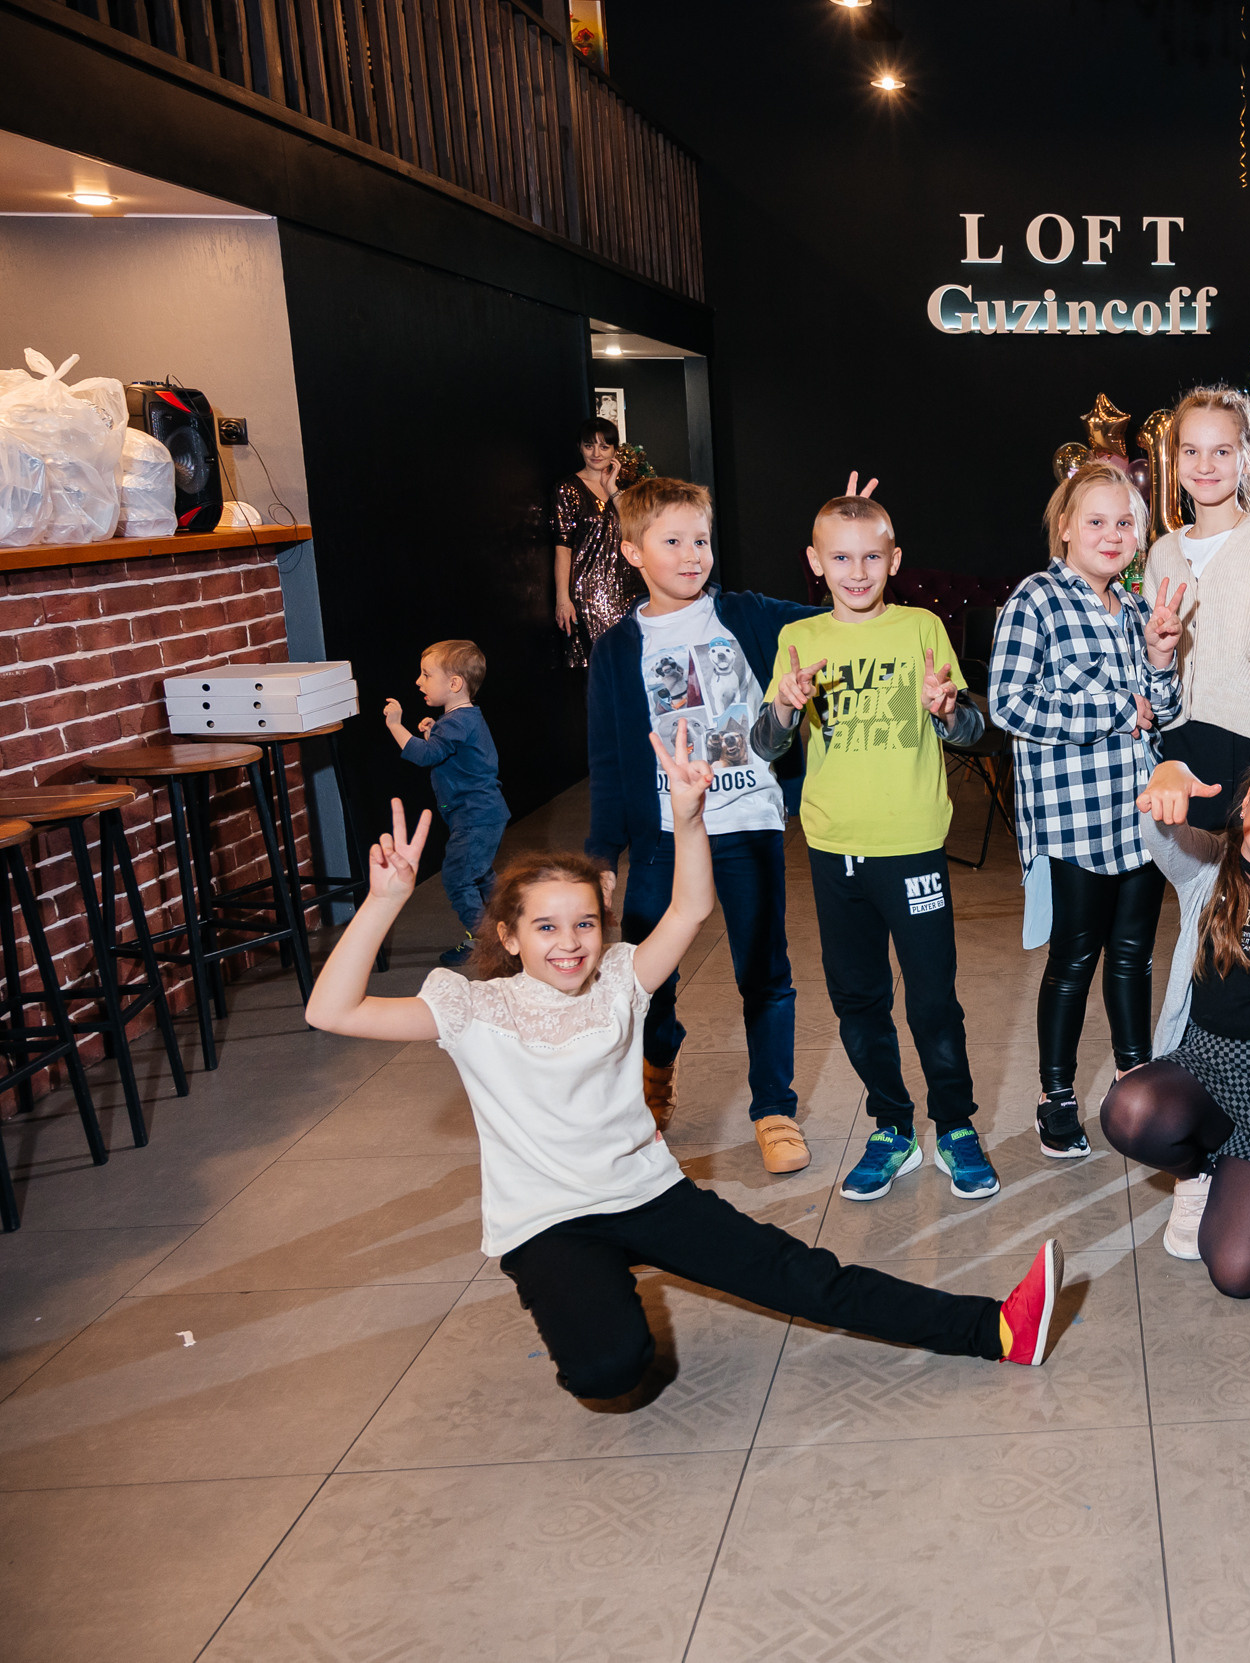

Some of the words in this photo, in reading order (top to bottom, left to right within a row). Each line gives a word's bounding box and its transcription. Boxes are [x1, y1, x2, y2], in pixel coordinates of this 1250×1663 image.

[959, 213, 1184, 265] LOFT
[927, 284, 1218, 335] Guzincoff
[816, 657, 916, 690] NEVER
[827, 688, 899, 726] LOOK
[829, 720, 910, 753] BACK
[709, 770, 757, 792] DOGS
[904, 872, 942, 898] NYC
[912, 902, 937, 913] PLAYER
